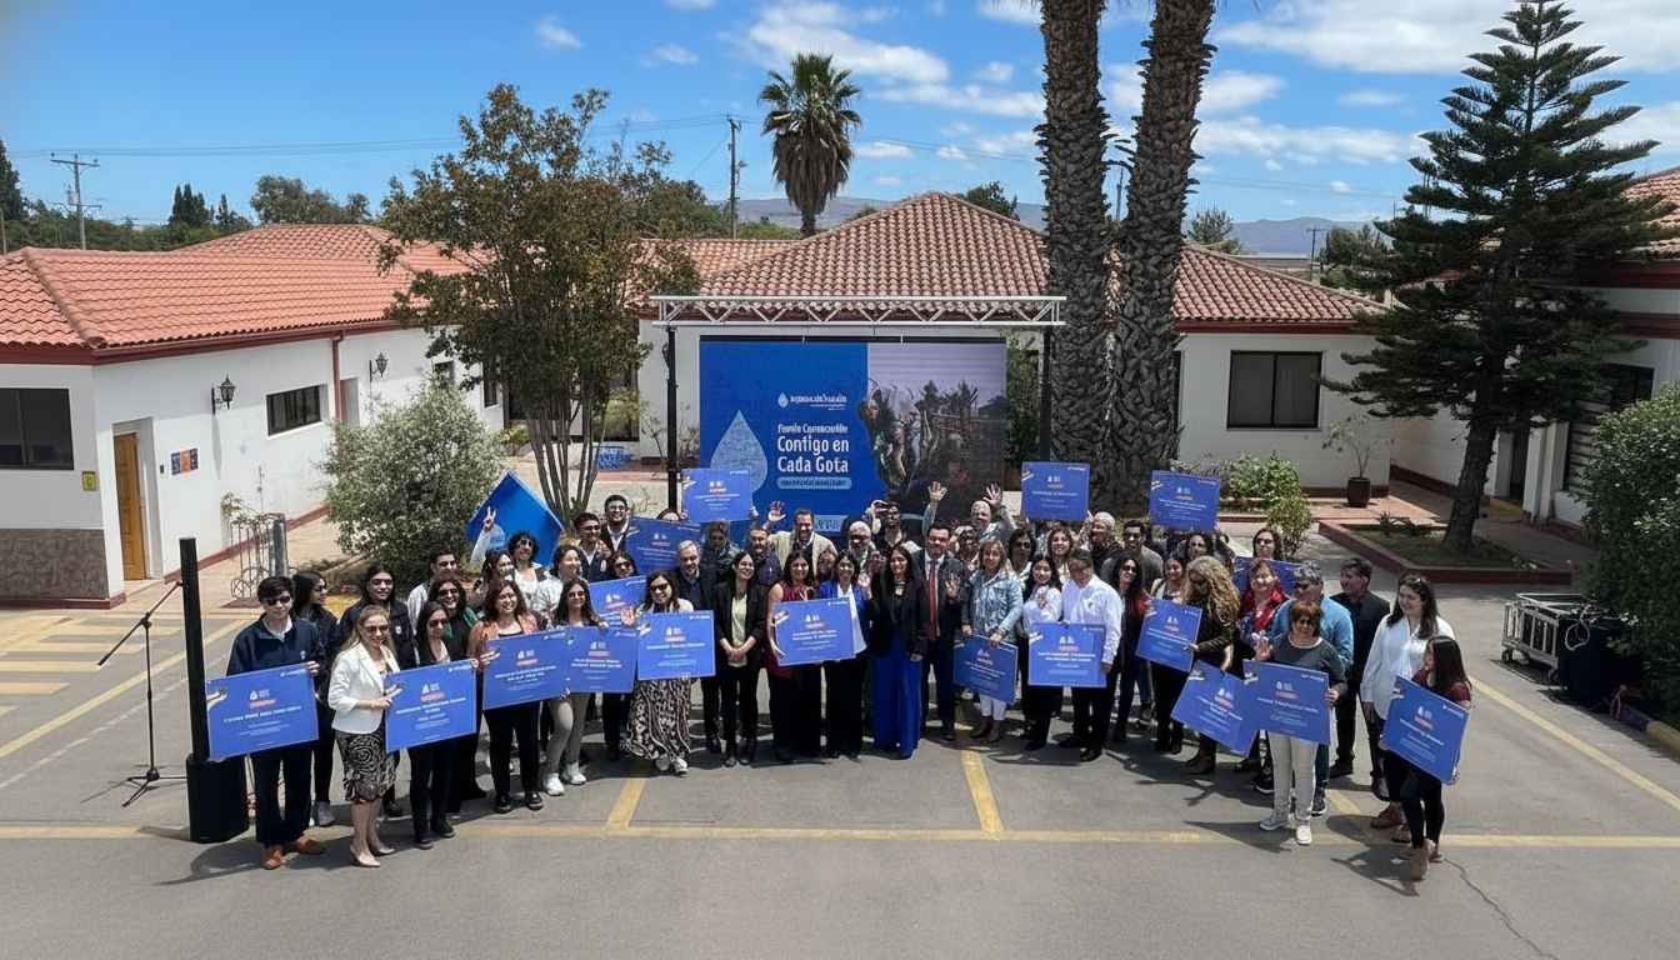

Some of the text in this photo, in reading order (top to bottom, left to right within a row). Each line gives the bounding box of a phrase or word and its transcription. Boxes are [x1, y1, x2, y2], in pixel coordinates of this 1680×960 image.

[778, 435, 849, 456] Contigo en
[778, 456, 849, 473] Cada Gota
